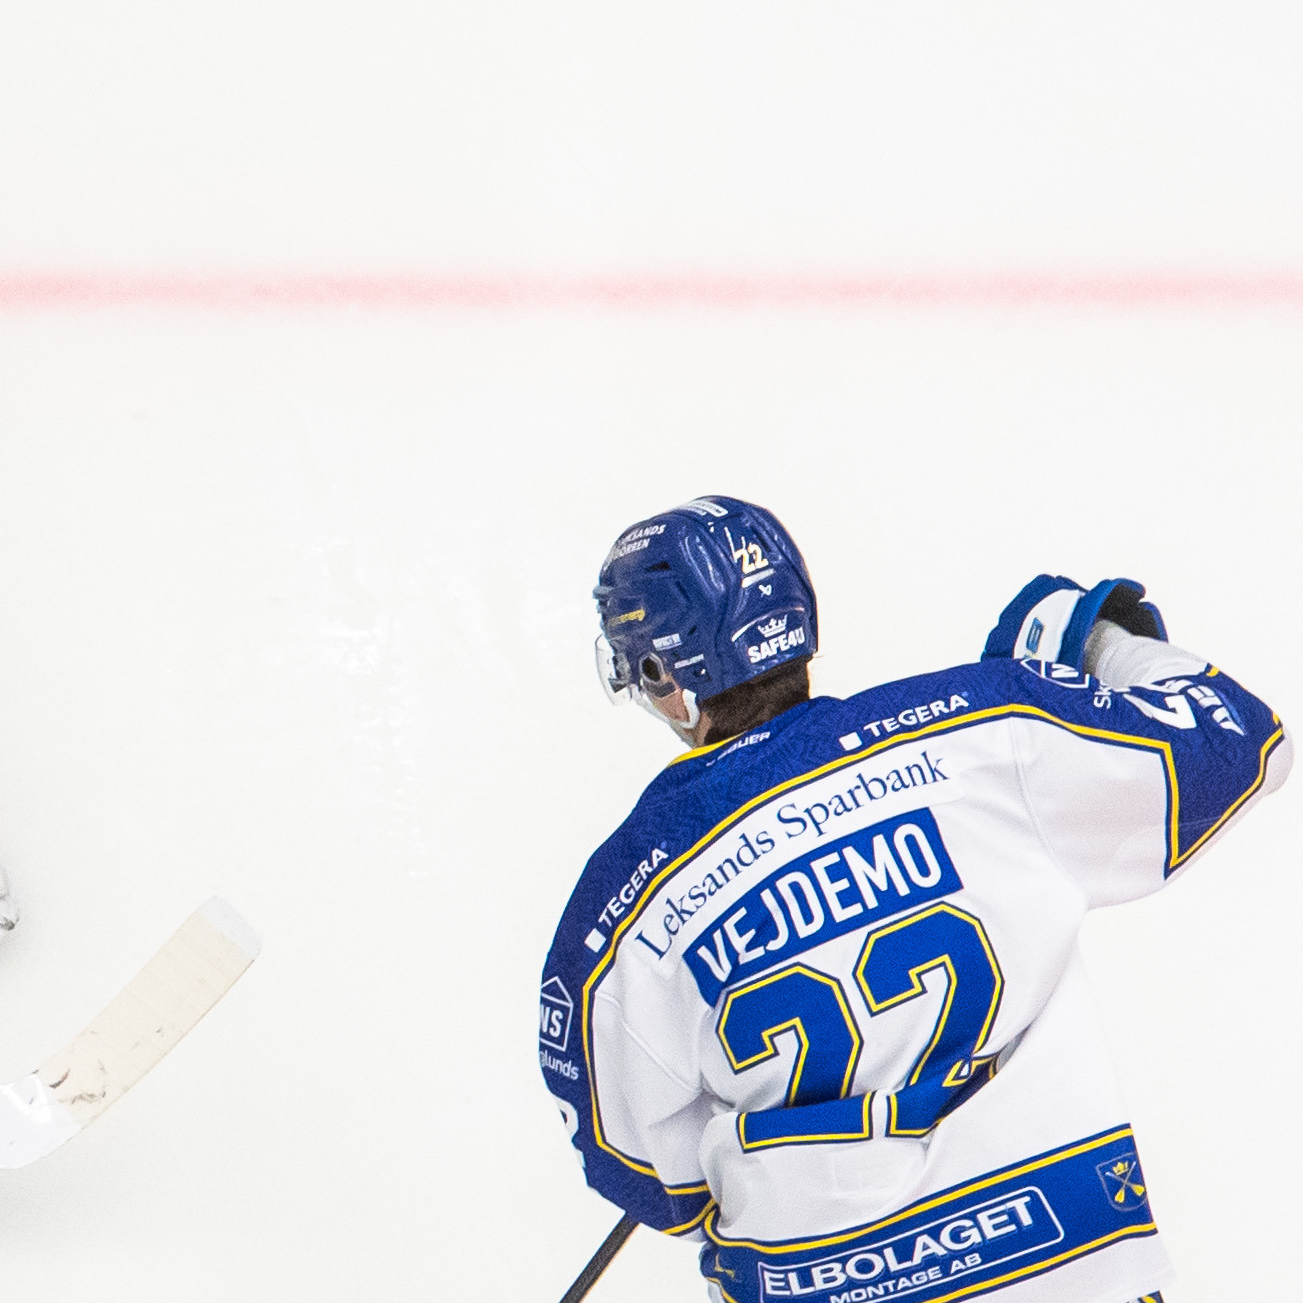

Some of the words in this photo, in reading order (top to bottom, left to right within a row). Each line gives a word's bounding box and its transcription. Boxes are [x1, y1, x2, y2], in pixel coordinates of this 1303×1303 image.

[746, 627, 806, 664] SAFE4U
[862, 692, 969, 741] TEGERA
[597, 845, 669, 929] TEGERA
[634, 834, 777, 962] Leksands
[782, 750, 952, 840] Sparbank
[695, 819, 945, 984] VEJDEMO
[715, 901, 1007, 1155] 22
[764, 1194, 1035, 1299] ELBOLAGET
[949, 1252, 984, 1278] AB
